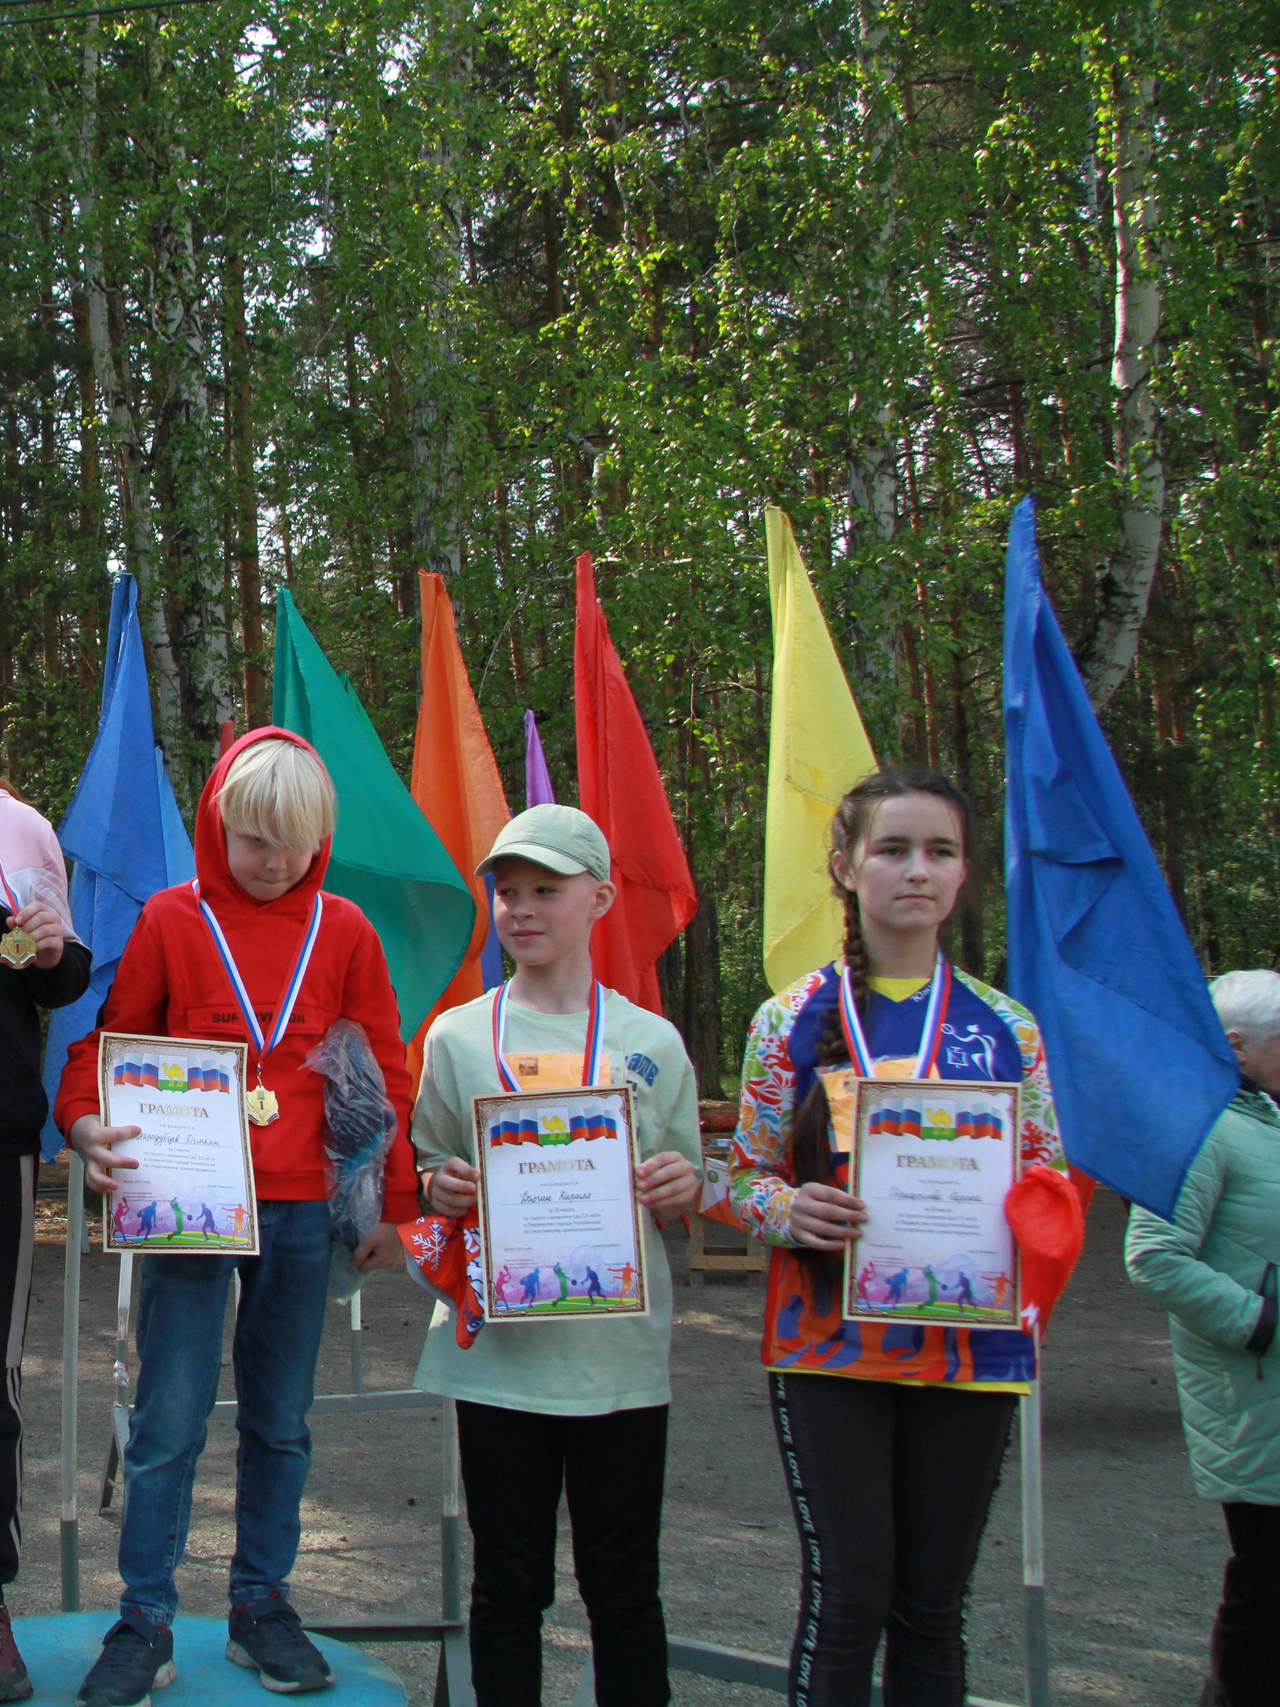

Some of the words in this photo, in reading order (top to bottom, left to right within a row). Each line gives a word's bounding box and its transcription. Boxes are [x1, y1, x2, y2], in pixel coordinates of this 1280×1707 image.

[15, 944, 20, 954] 1
[139, 1102, 210, 1118] ГРАМОТА
[260, 1100, 264, 1110] 1
[518, 1158, 596, 1175] ГРАМОТА
[896, 1154, 979, 1170] ГРАМОТА
[776, 1372, 786, 1400] OVE
[778, 1407, 793, 1445] LOVE
[786, 1451, 804, 1490] LOVE
[796, 1496, 816, 1534] LOVE
[808, 1538, 822, 1574] LOVE
[810, 1580, 822, 1617] LOVE
[802, 1618, 820, 1651] LOVE
[796, 1653, 814, 1689] LOVE
